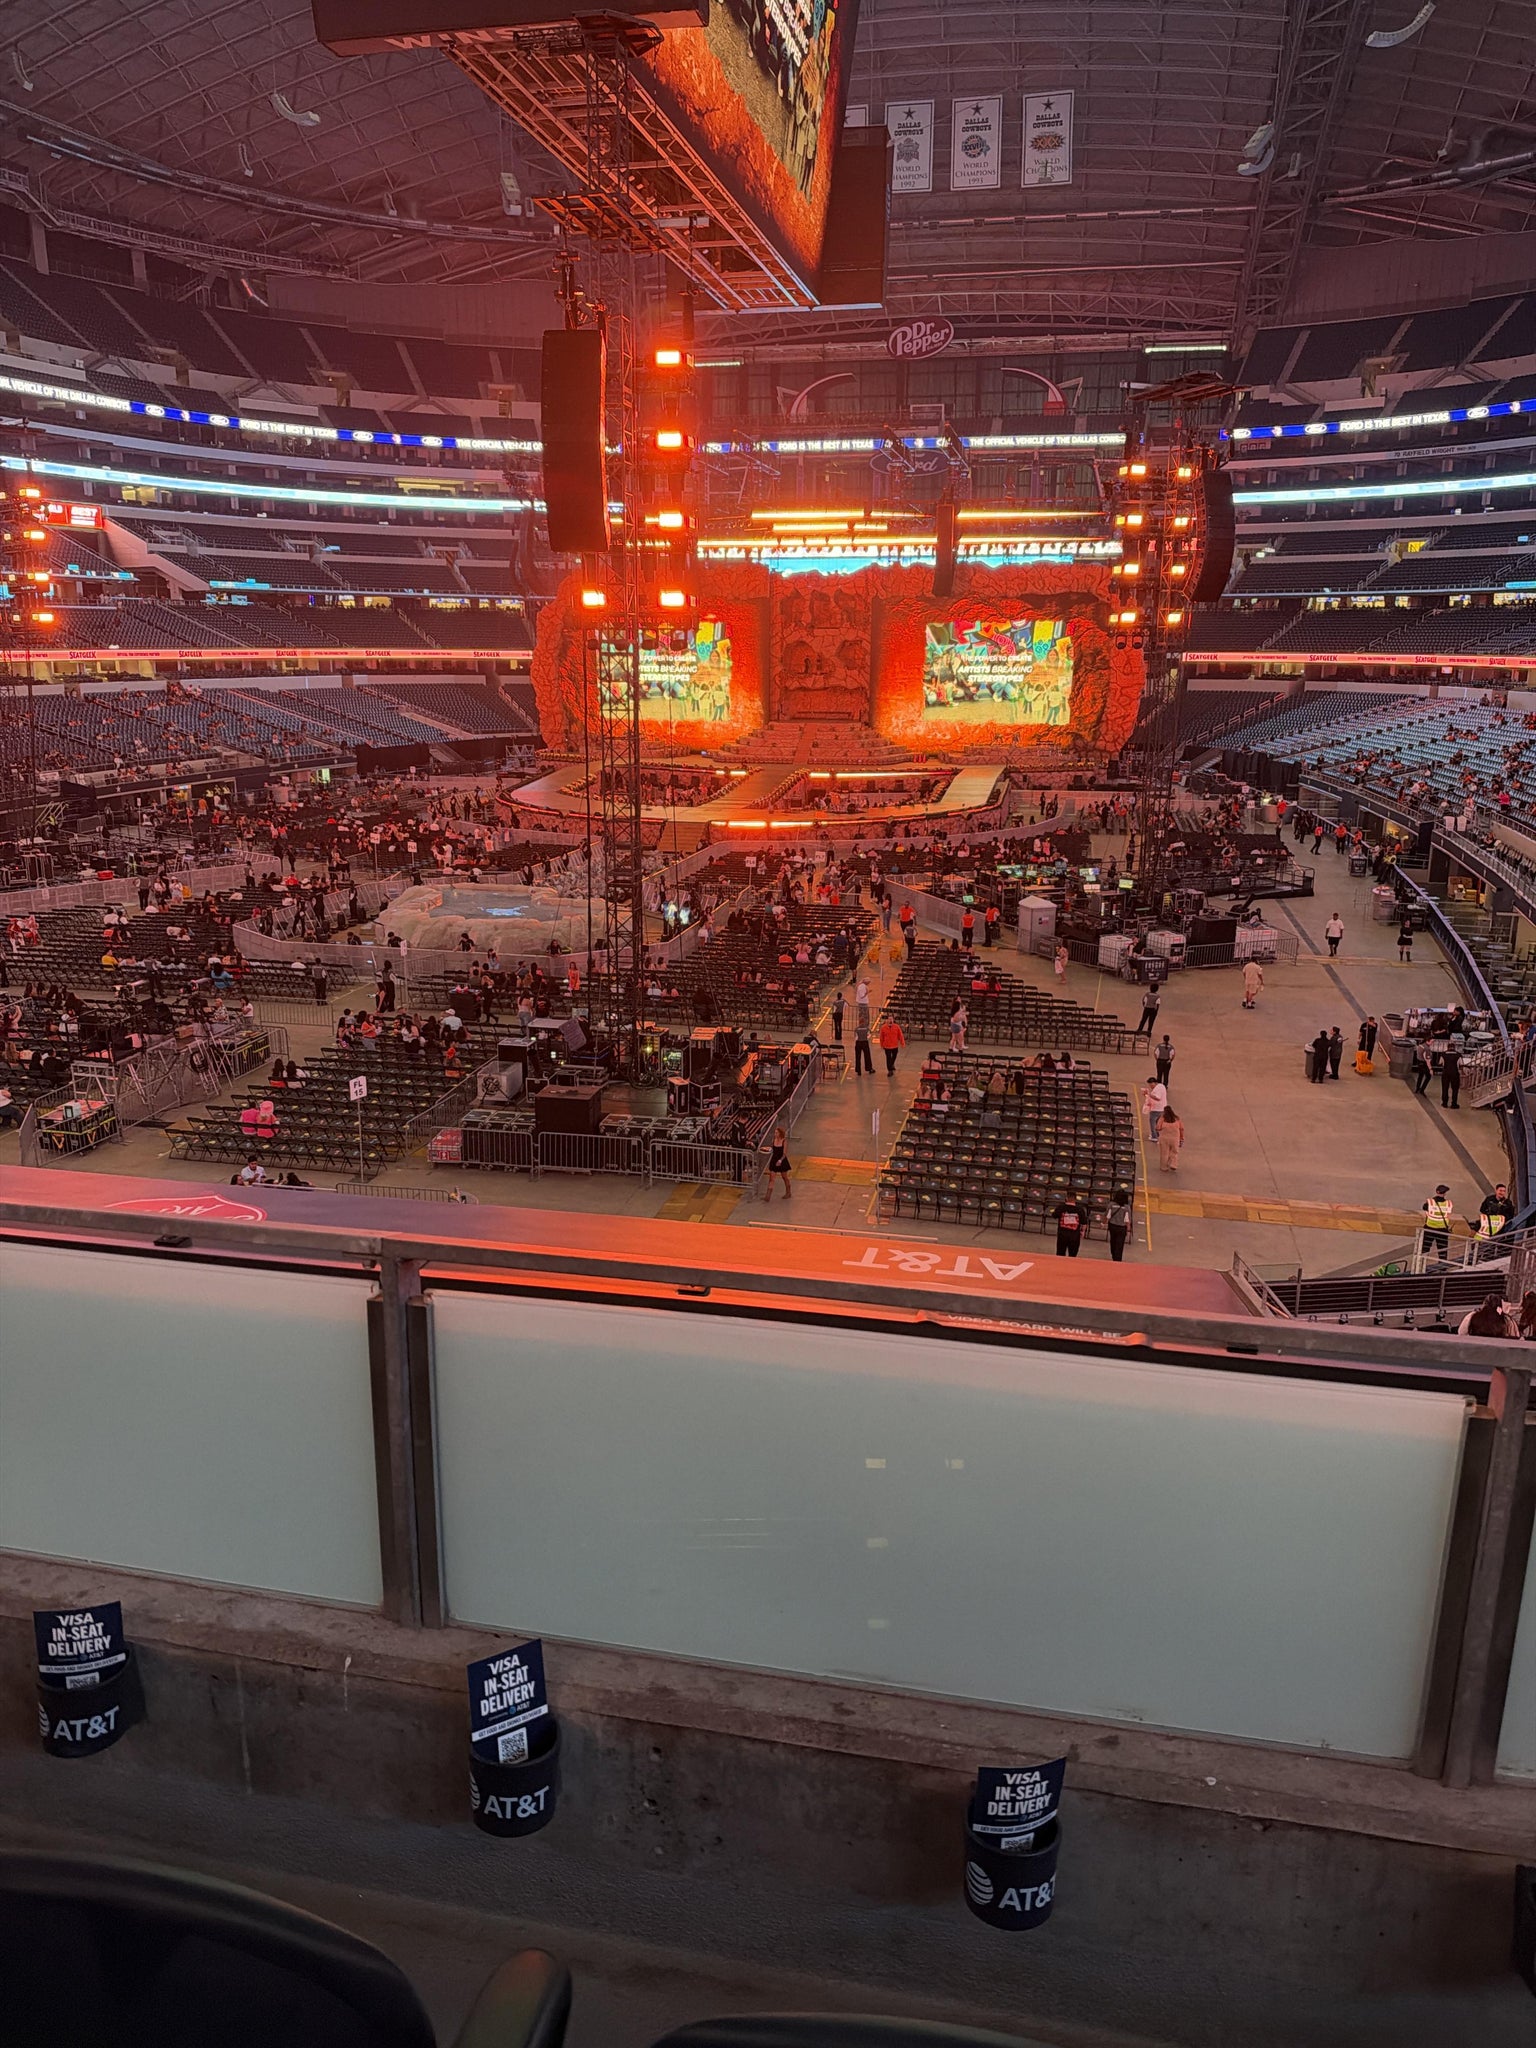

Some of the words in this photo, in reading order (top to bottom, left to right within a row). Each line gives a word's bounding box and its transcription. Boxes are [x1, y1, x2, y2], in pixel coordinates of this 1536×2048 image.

[965, 117, 989, 125] DALLAS
[1033, 120, 1063, 129] COWBOYS
[1036, 113, 1061, 121] DALLAS
[894, 128, 923, 136] COWBOYS
[962, 124, 992, 133] COWBOYS
[955, 169, 997, 178] CHAMPIONS
[912, 321, 935, 339] Dr
[891, 325, 949, 356] Pepper
[70, 651, 96, 659] SEATGEEK
[354, 1081, 363, 1089] FL
[354, 1088, 363, 1097] 15
[842, 1247, 1035, 1281] AT&T
[948, 1315, 993, 1324] VIDEO
[999, 1320, 1054, 1331] BOARD
[1060, 1327, 1096, 1336] WILL
[56, 1612, 94, 1627] VISA
[52, 1622, 104, 1642] IN-SEAT
[47, 1635, 111, 1657] DELIVERY
[487, 1654, 520, 1675] VISA
[484, 1665, 529, 1697] IN-SEAT
[480, 1680, 535, 1717] DELIVERY
[53, 1705, 119, 1741] AT&T
[1003, 1771, 1041, 1785] VISA
[995, 1780, 1049, 1800] IN-SEAT
[484, 1785, 550, 1819] AT&T
[987, 1793, 1052, 1816] DELIVERY
